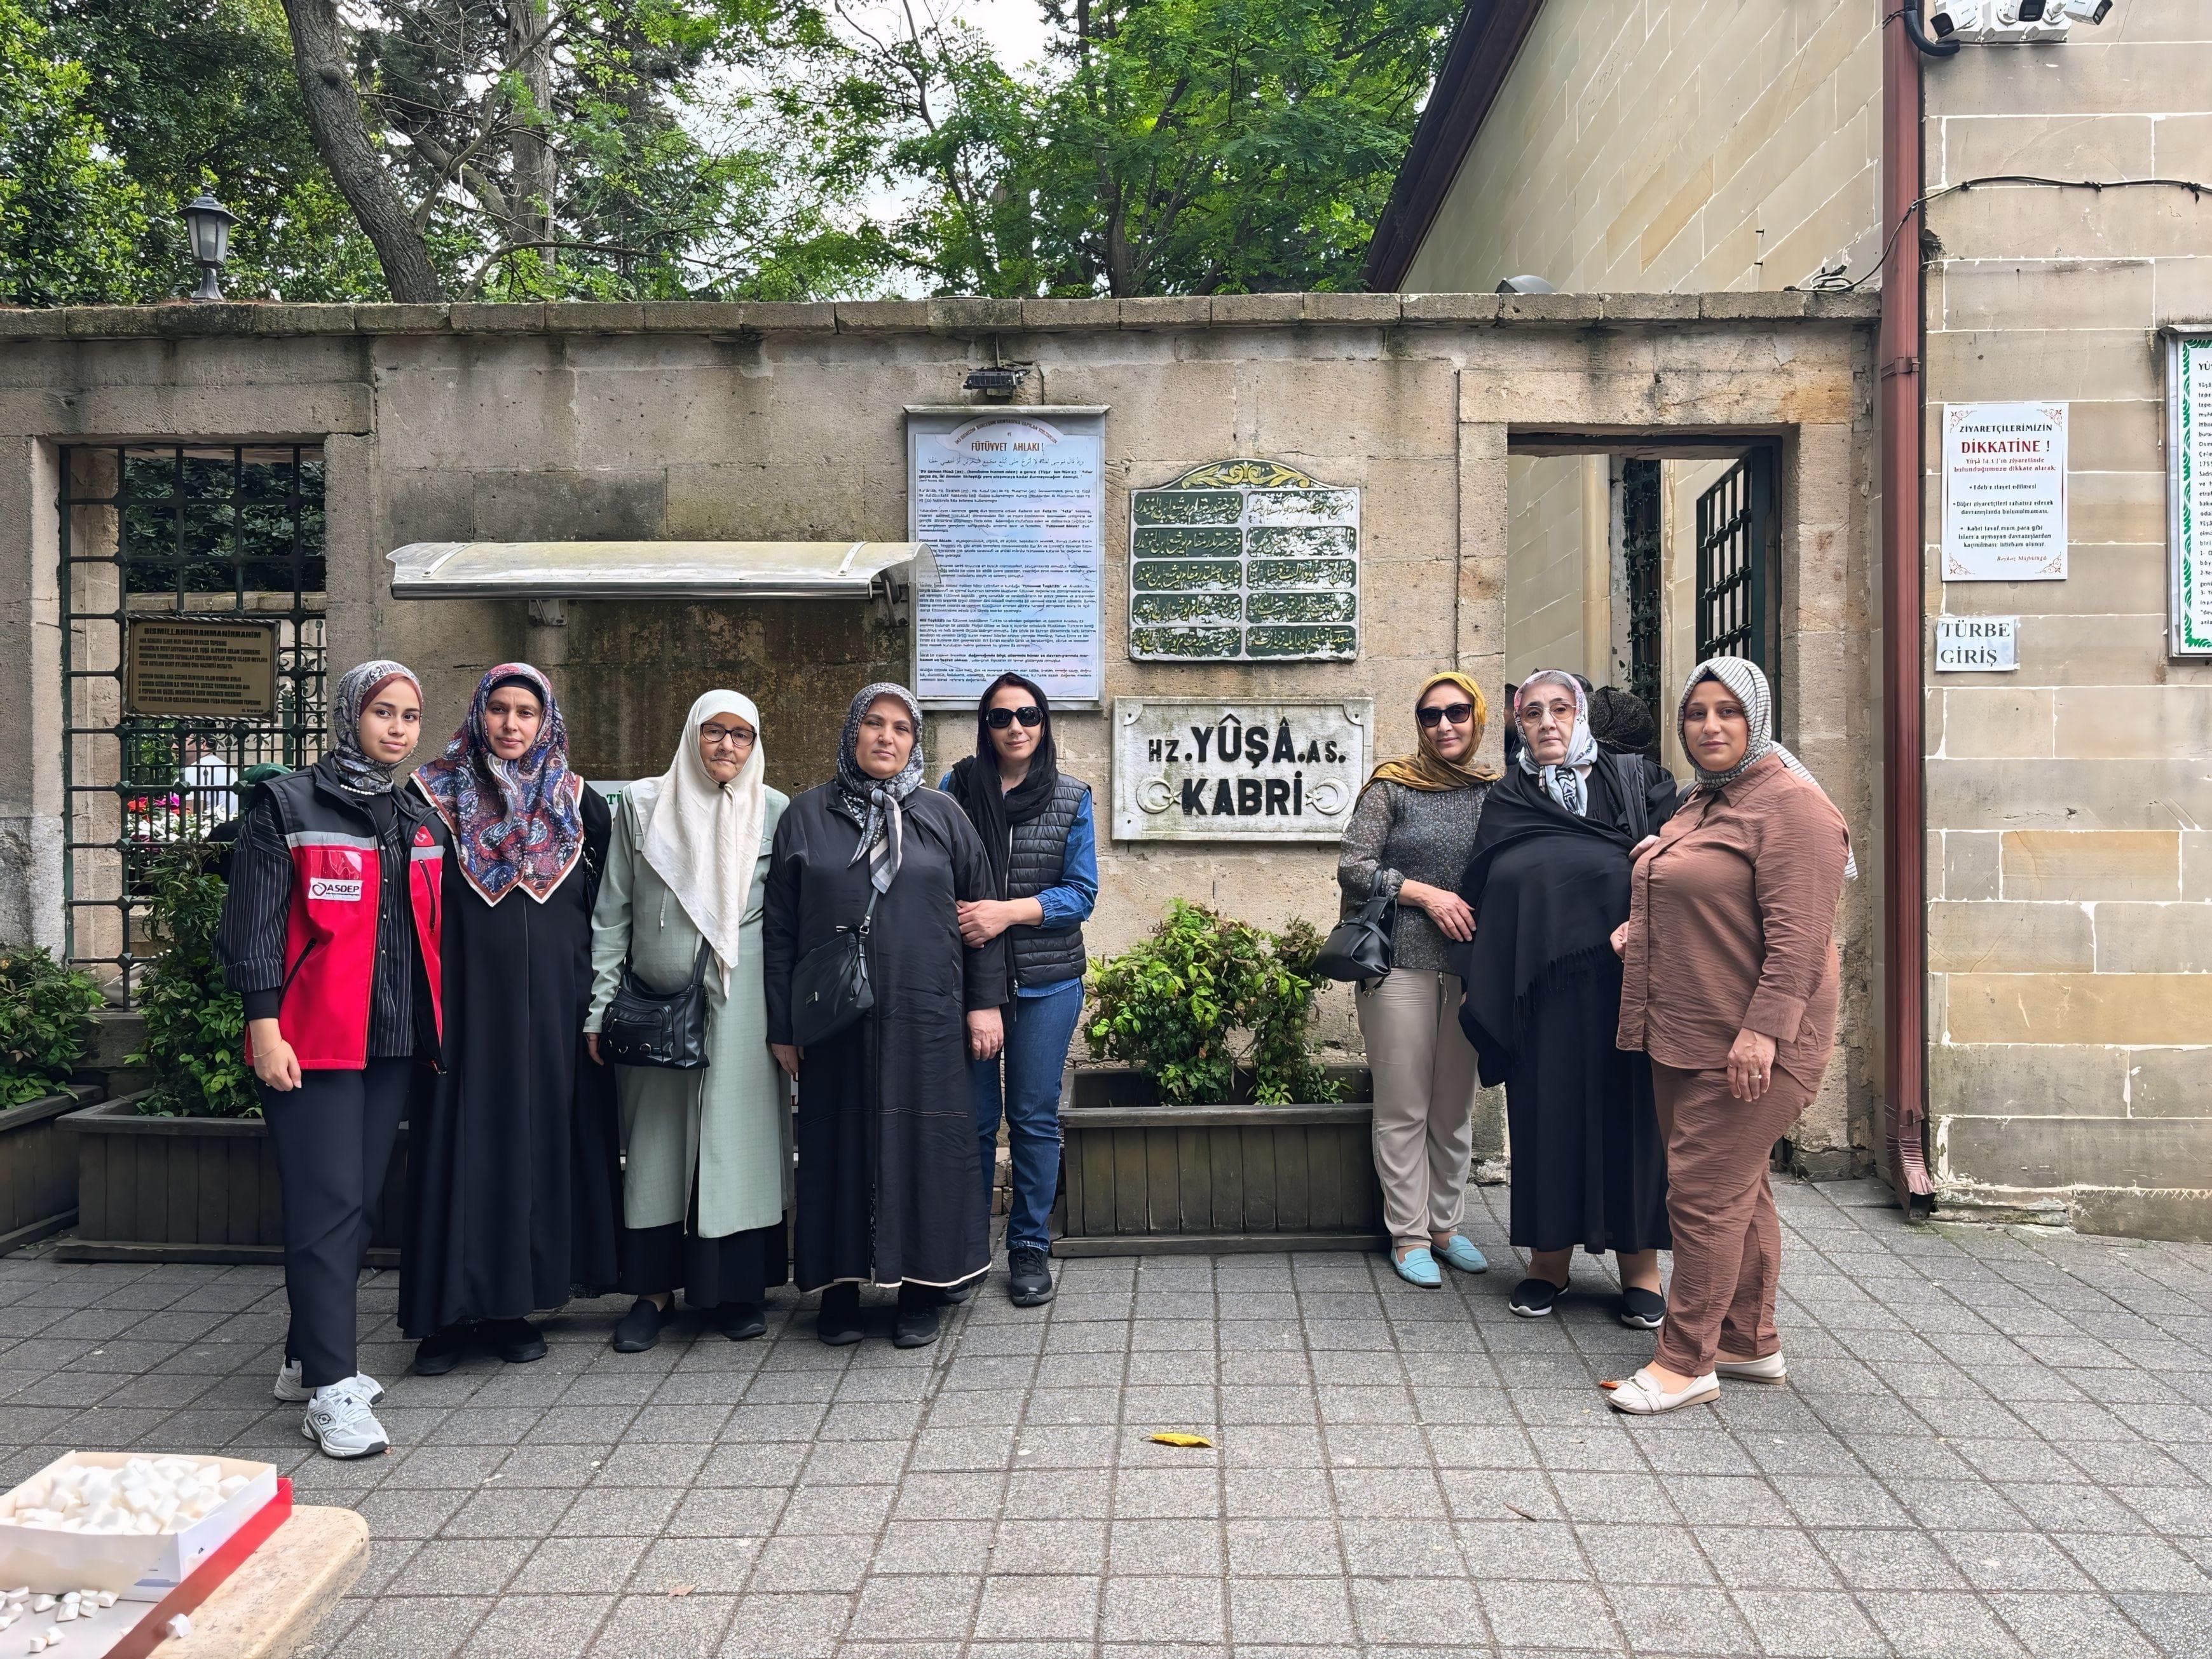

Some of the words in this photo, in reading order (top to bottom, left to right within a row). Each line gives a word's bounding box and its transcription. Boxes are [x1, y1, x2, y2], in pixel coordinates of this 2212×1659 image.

[2199, 361, 2212, 371] YÛ
[1960, 423, 2052, 434] ZİYARETÇİLERİMİZİN
[971, 440, 1007, 451] FÜTÜVVET
[1013, 442, 1040, 451] AHLAKI
[1962, 438, 2040, 453] DİKKATİNE
[1941, 620, 2010, 637] TÜRBE
[1941, 646, 1997, 667] GİRİŞ
[1181, 770, 1302, 816] KABRİ
[327, 884, 360, 892] ASDEP
